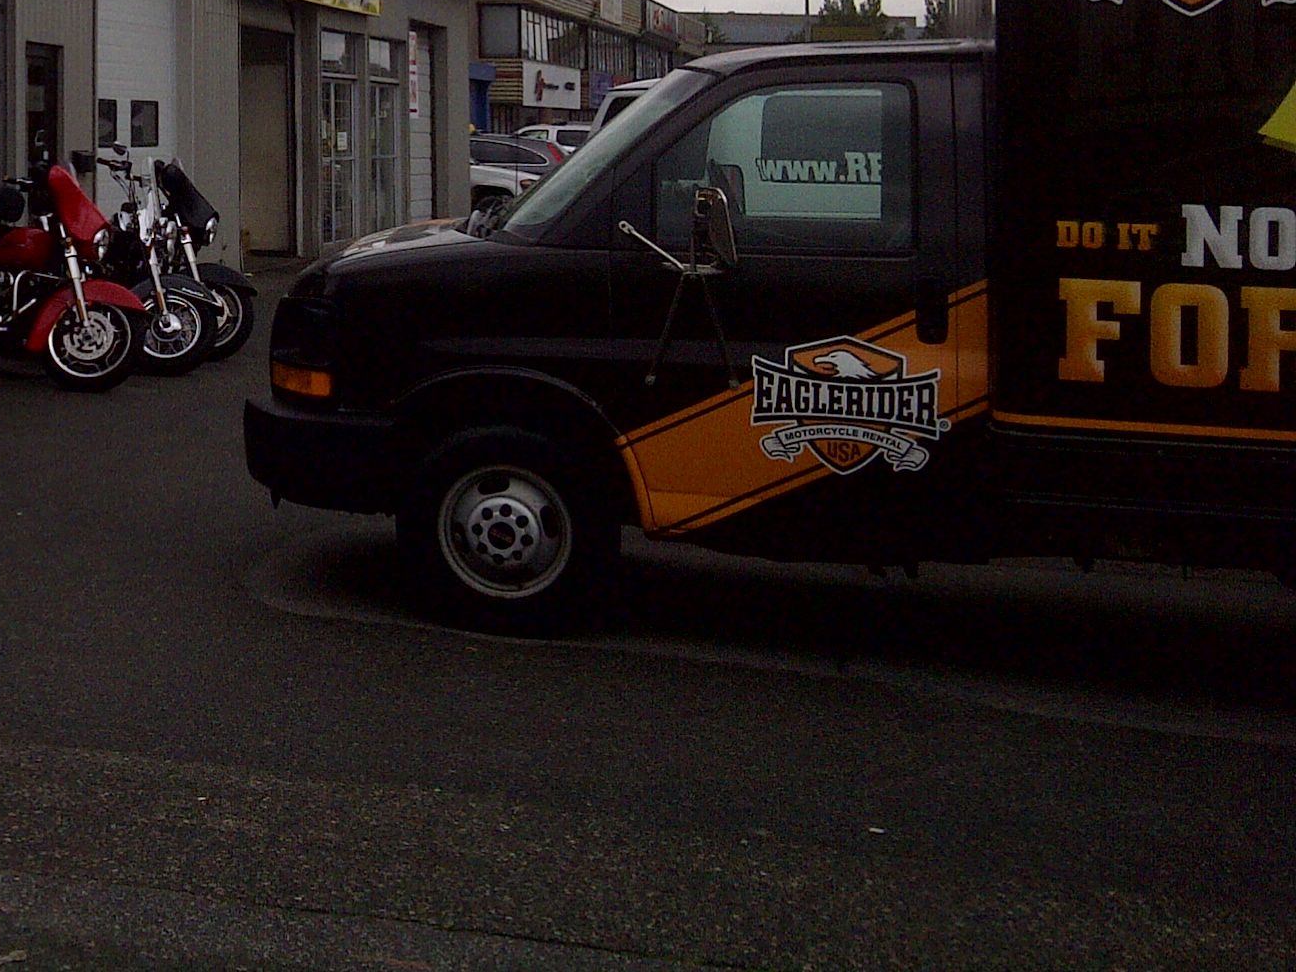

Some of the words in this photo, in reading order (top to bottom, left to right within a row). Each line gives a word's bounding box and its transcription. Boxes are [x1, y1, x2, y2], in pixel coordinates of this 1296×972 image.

[1056, 220, 1104, 249] DO
[1117, 223, 1159, 251] IT
[755, 369, 935, 428] EAGLERIDER
[785, 427, 858, 441] MOTORCYCLE
[862, 431, 902, 450] RENTAL
[827, 441, 861, 462] USA
